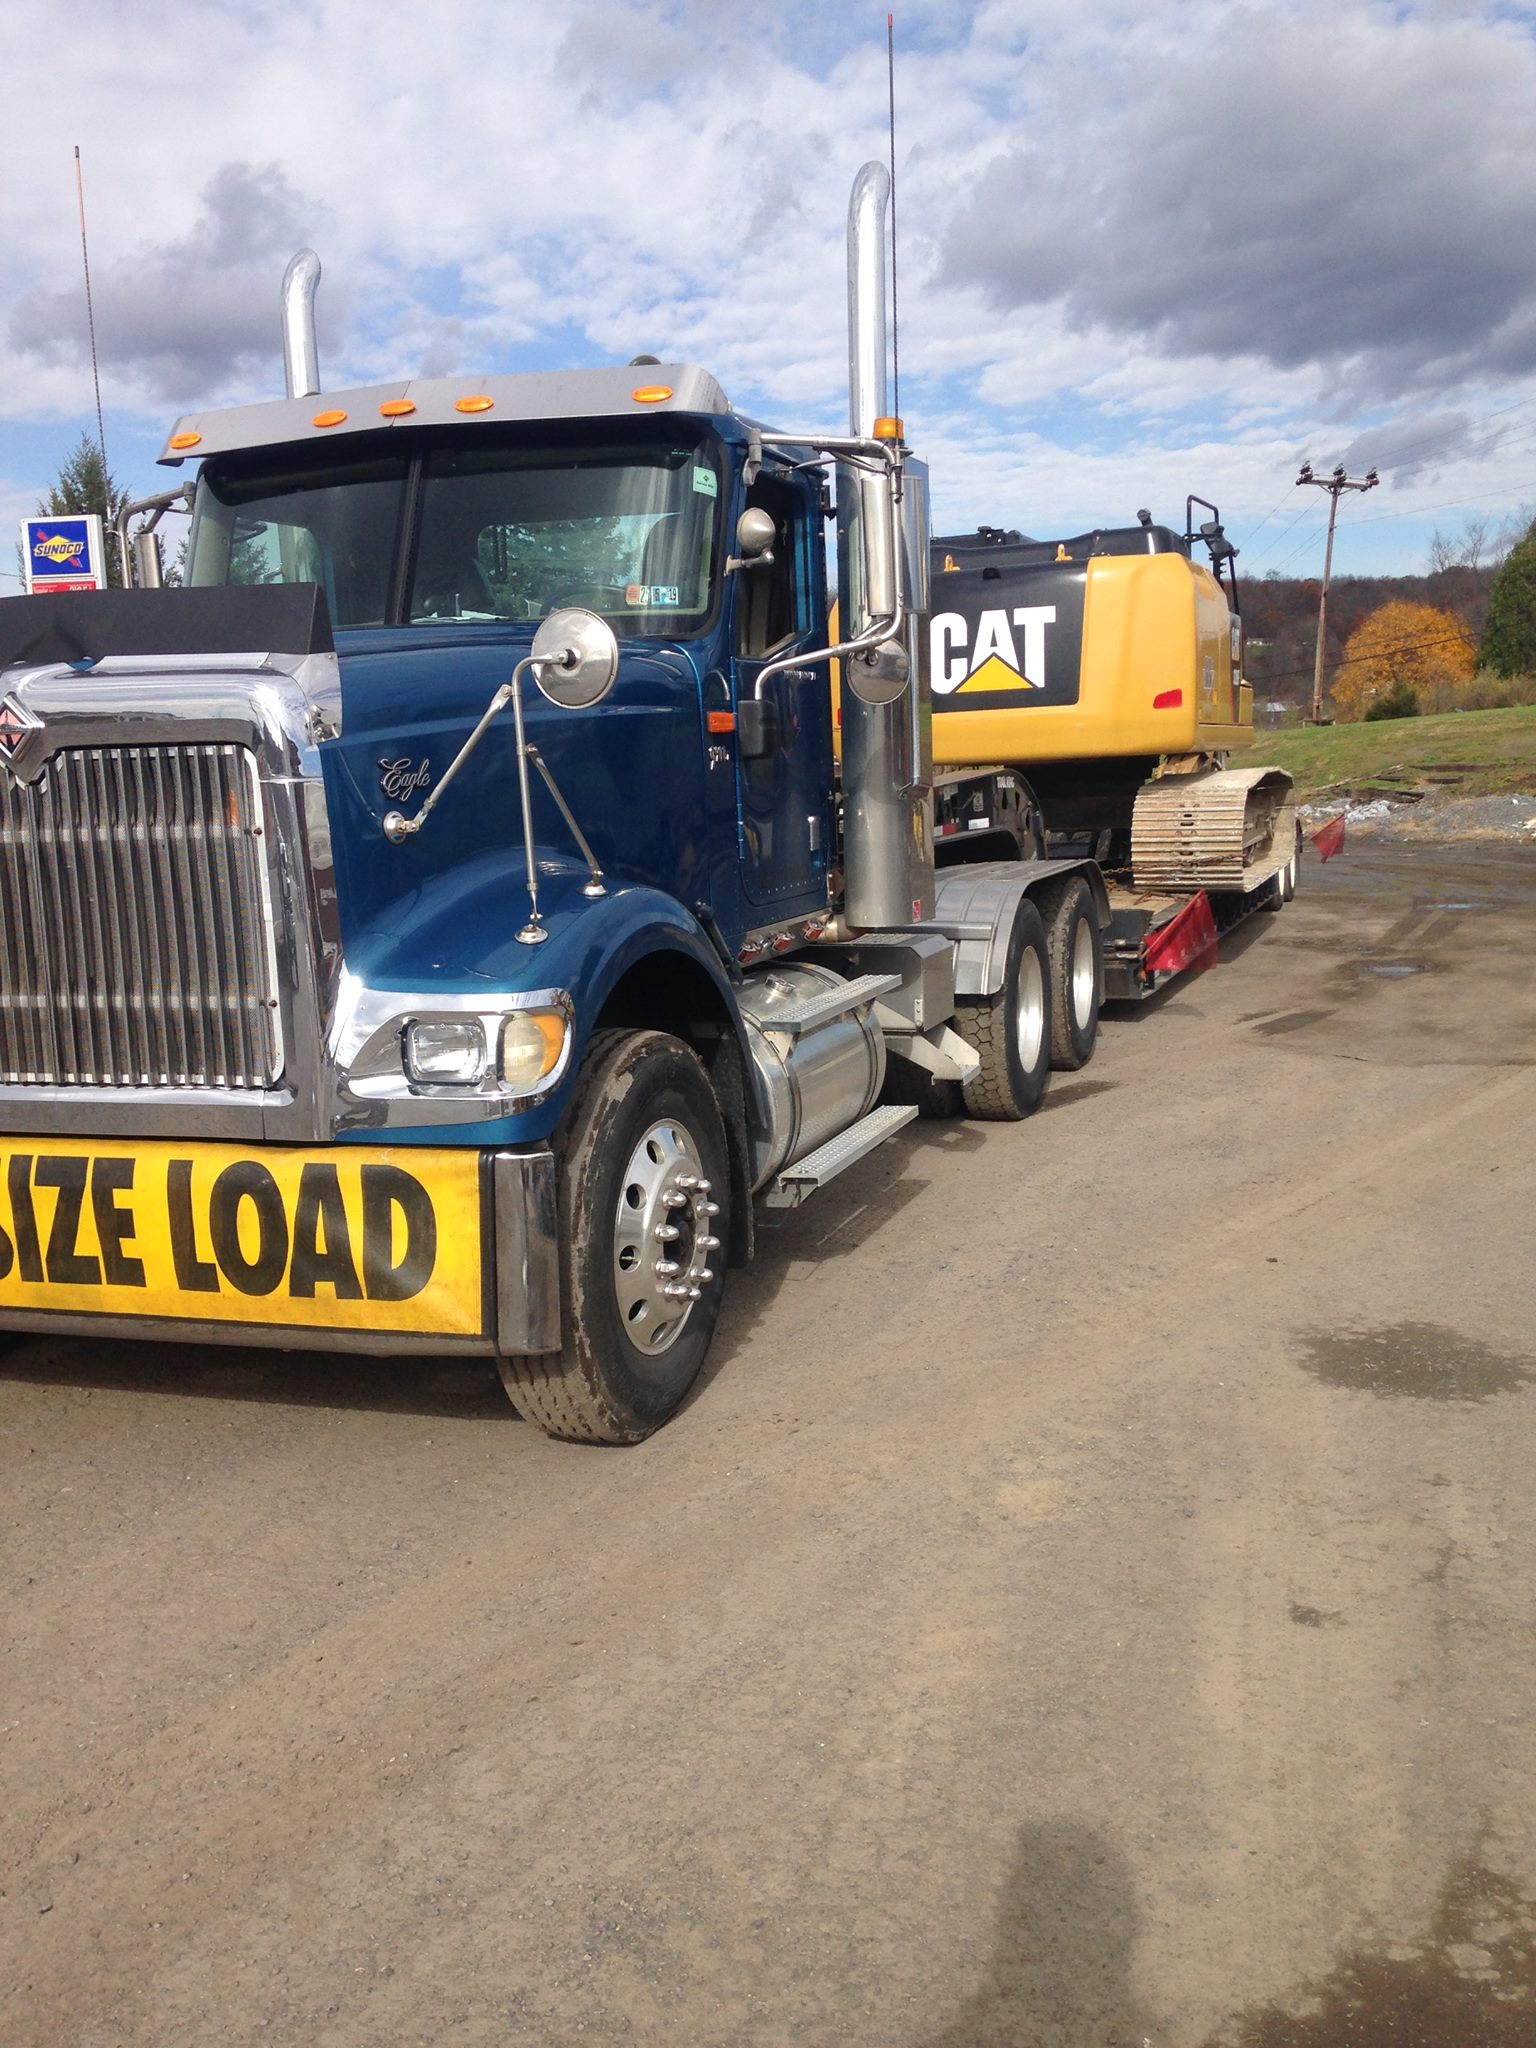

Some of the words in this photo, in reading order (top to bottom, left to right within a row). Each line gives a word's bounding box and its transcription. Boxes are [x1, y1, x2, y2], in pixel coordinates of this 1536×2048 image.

[36, 543, 82, 556] SUNOCO
[930, 606, 1056, 695] CAT
[378, 758, 431, 802] Eagle
[167, 1159, 438, 1301] LOAD
